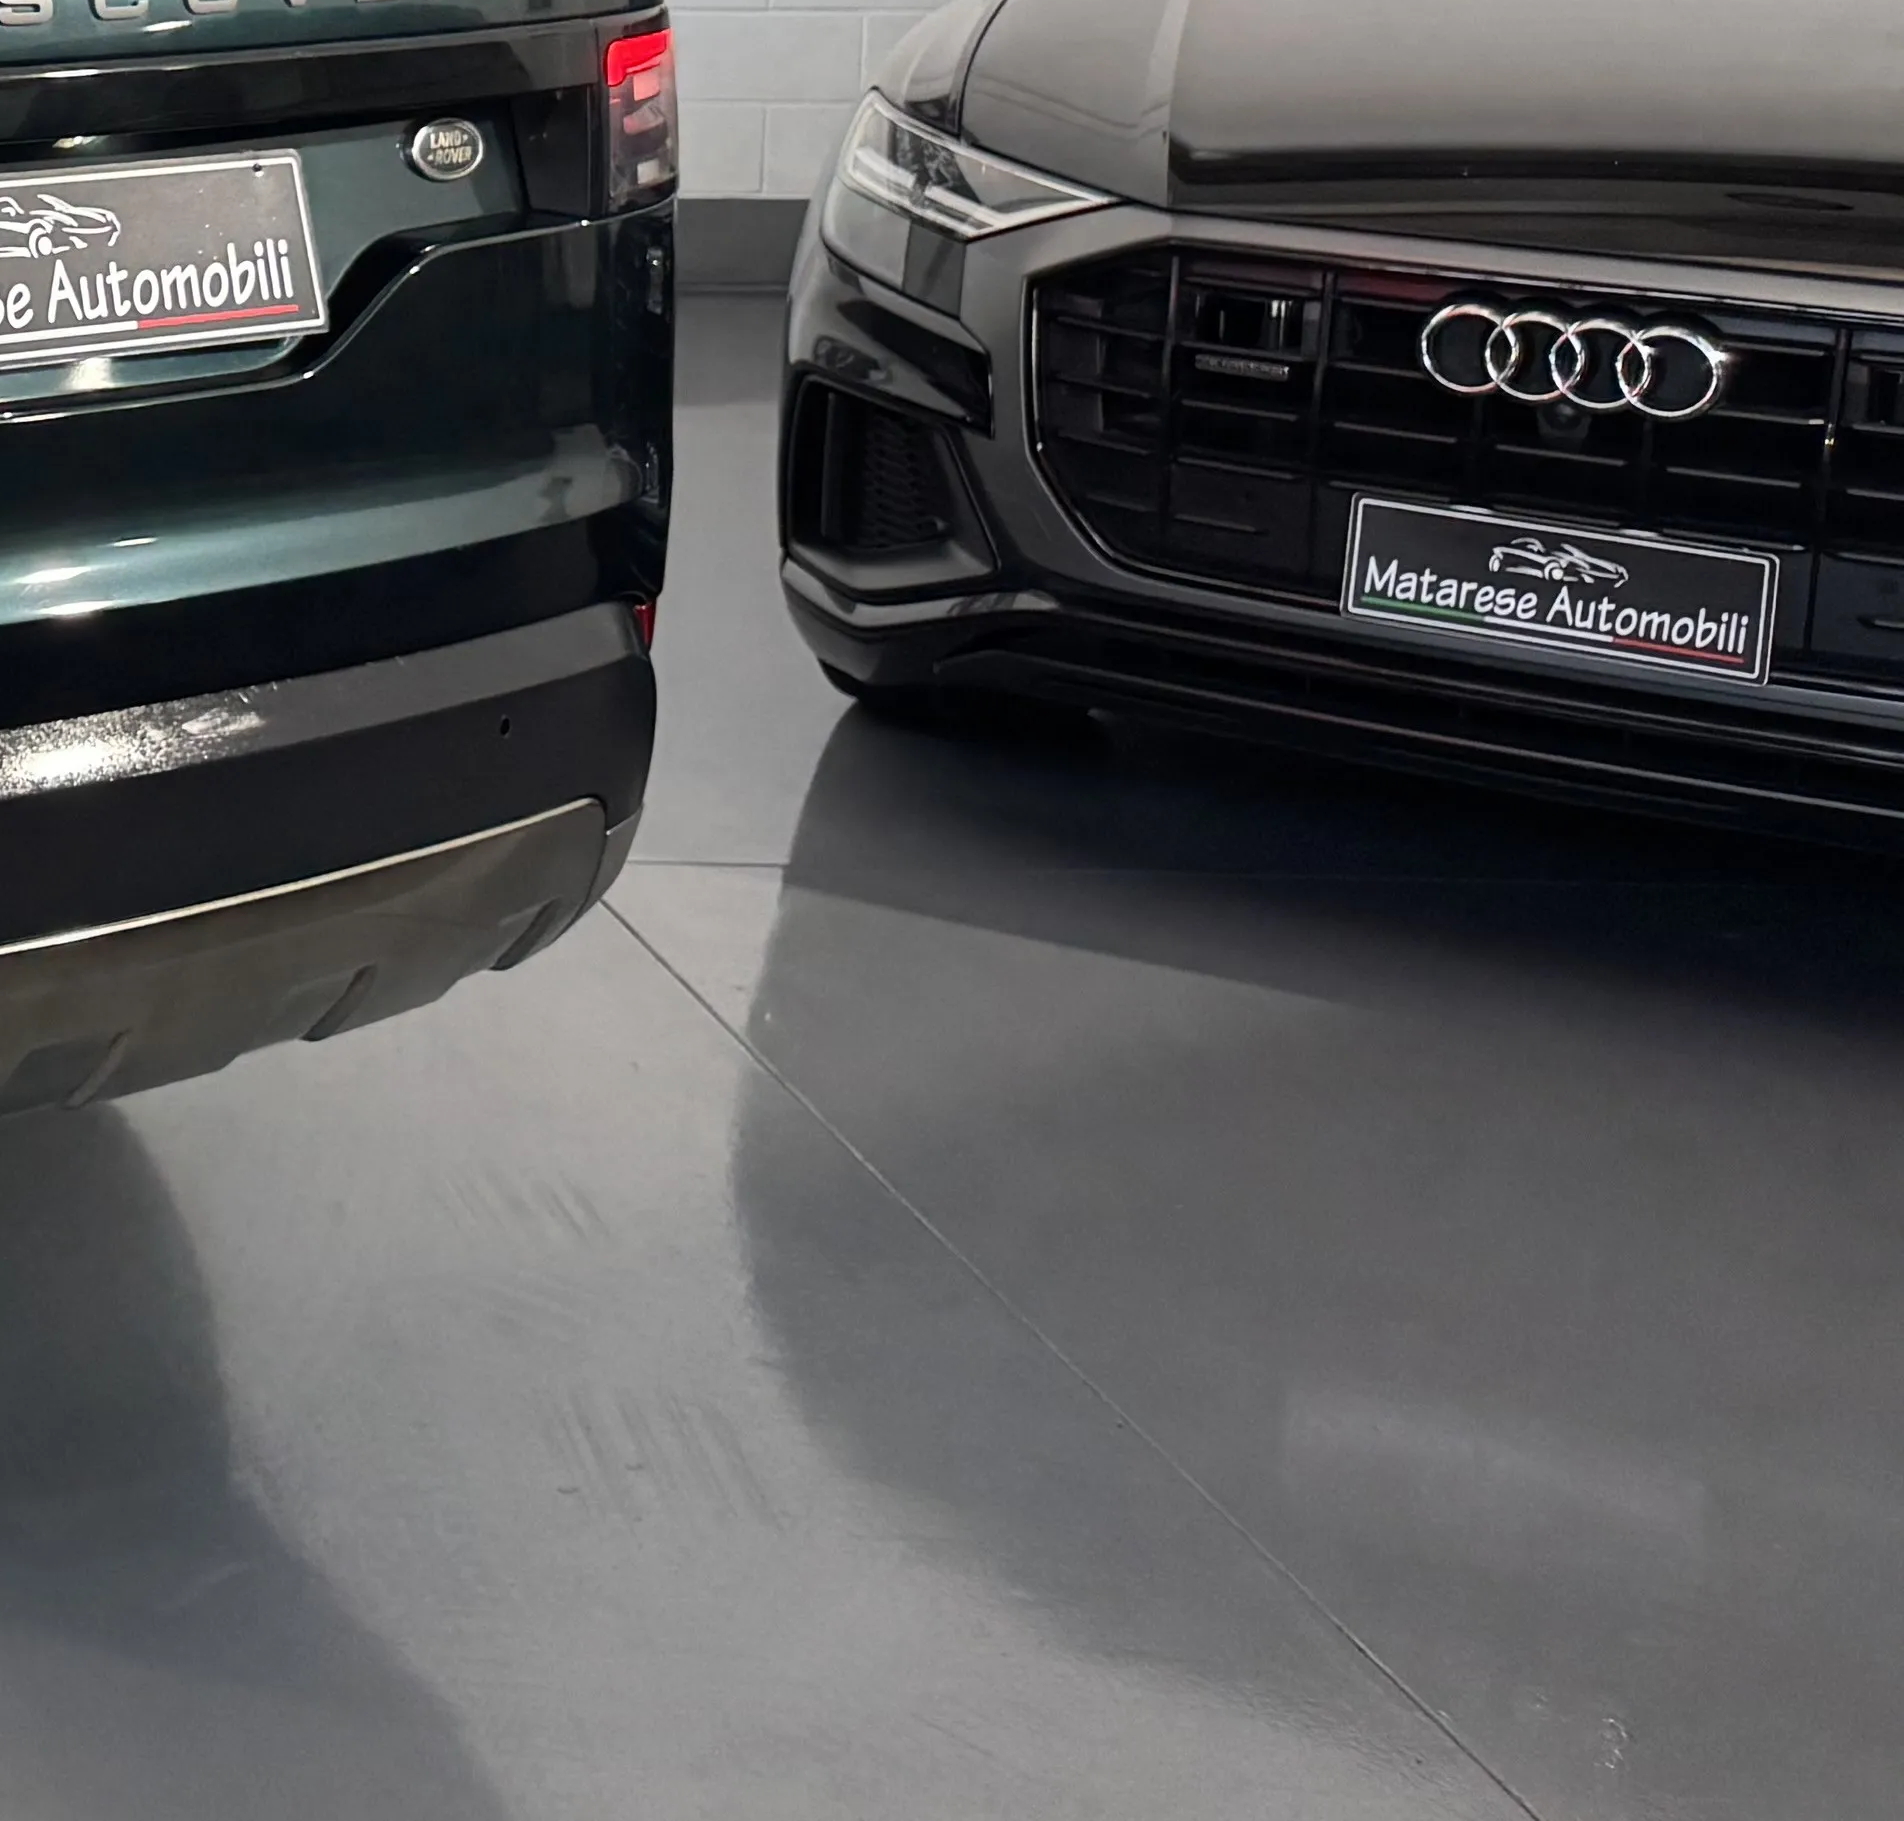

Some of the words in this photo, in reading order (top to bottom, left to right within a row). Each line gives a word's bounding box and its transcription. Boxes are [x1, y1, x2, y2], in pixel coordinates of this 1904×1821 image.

[430, 130, 462, 149] LAND
[435, 146, 472, 165] ROVER
[47, 237, 294, 324] Automobili
[1364, 555, 1538, 620] Matarese
[1545, 585, 1750, 654] Automobili
